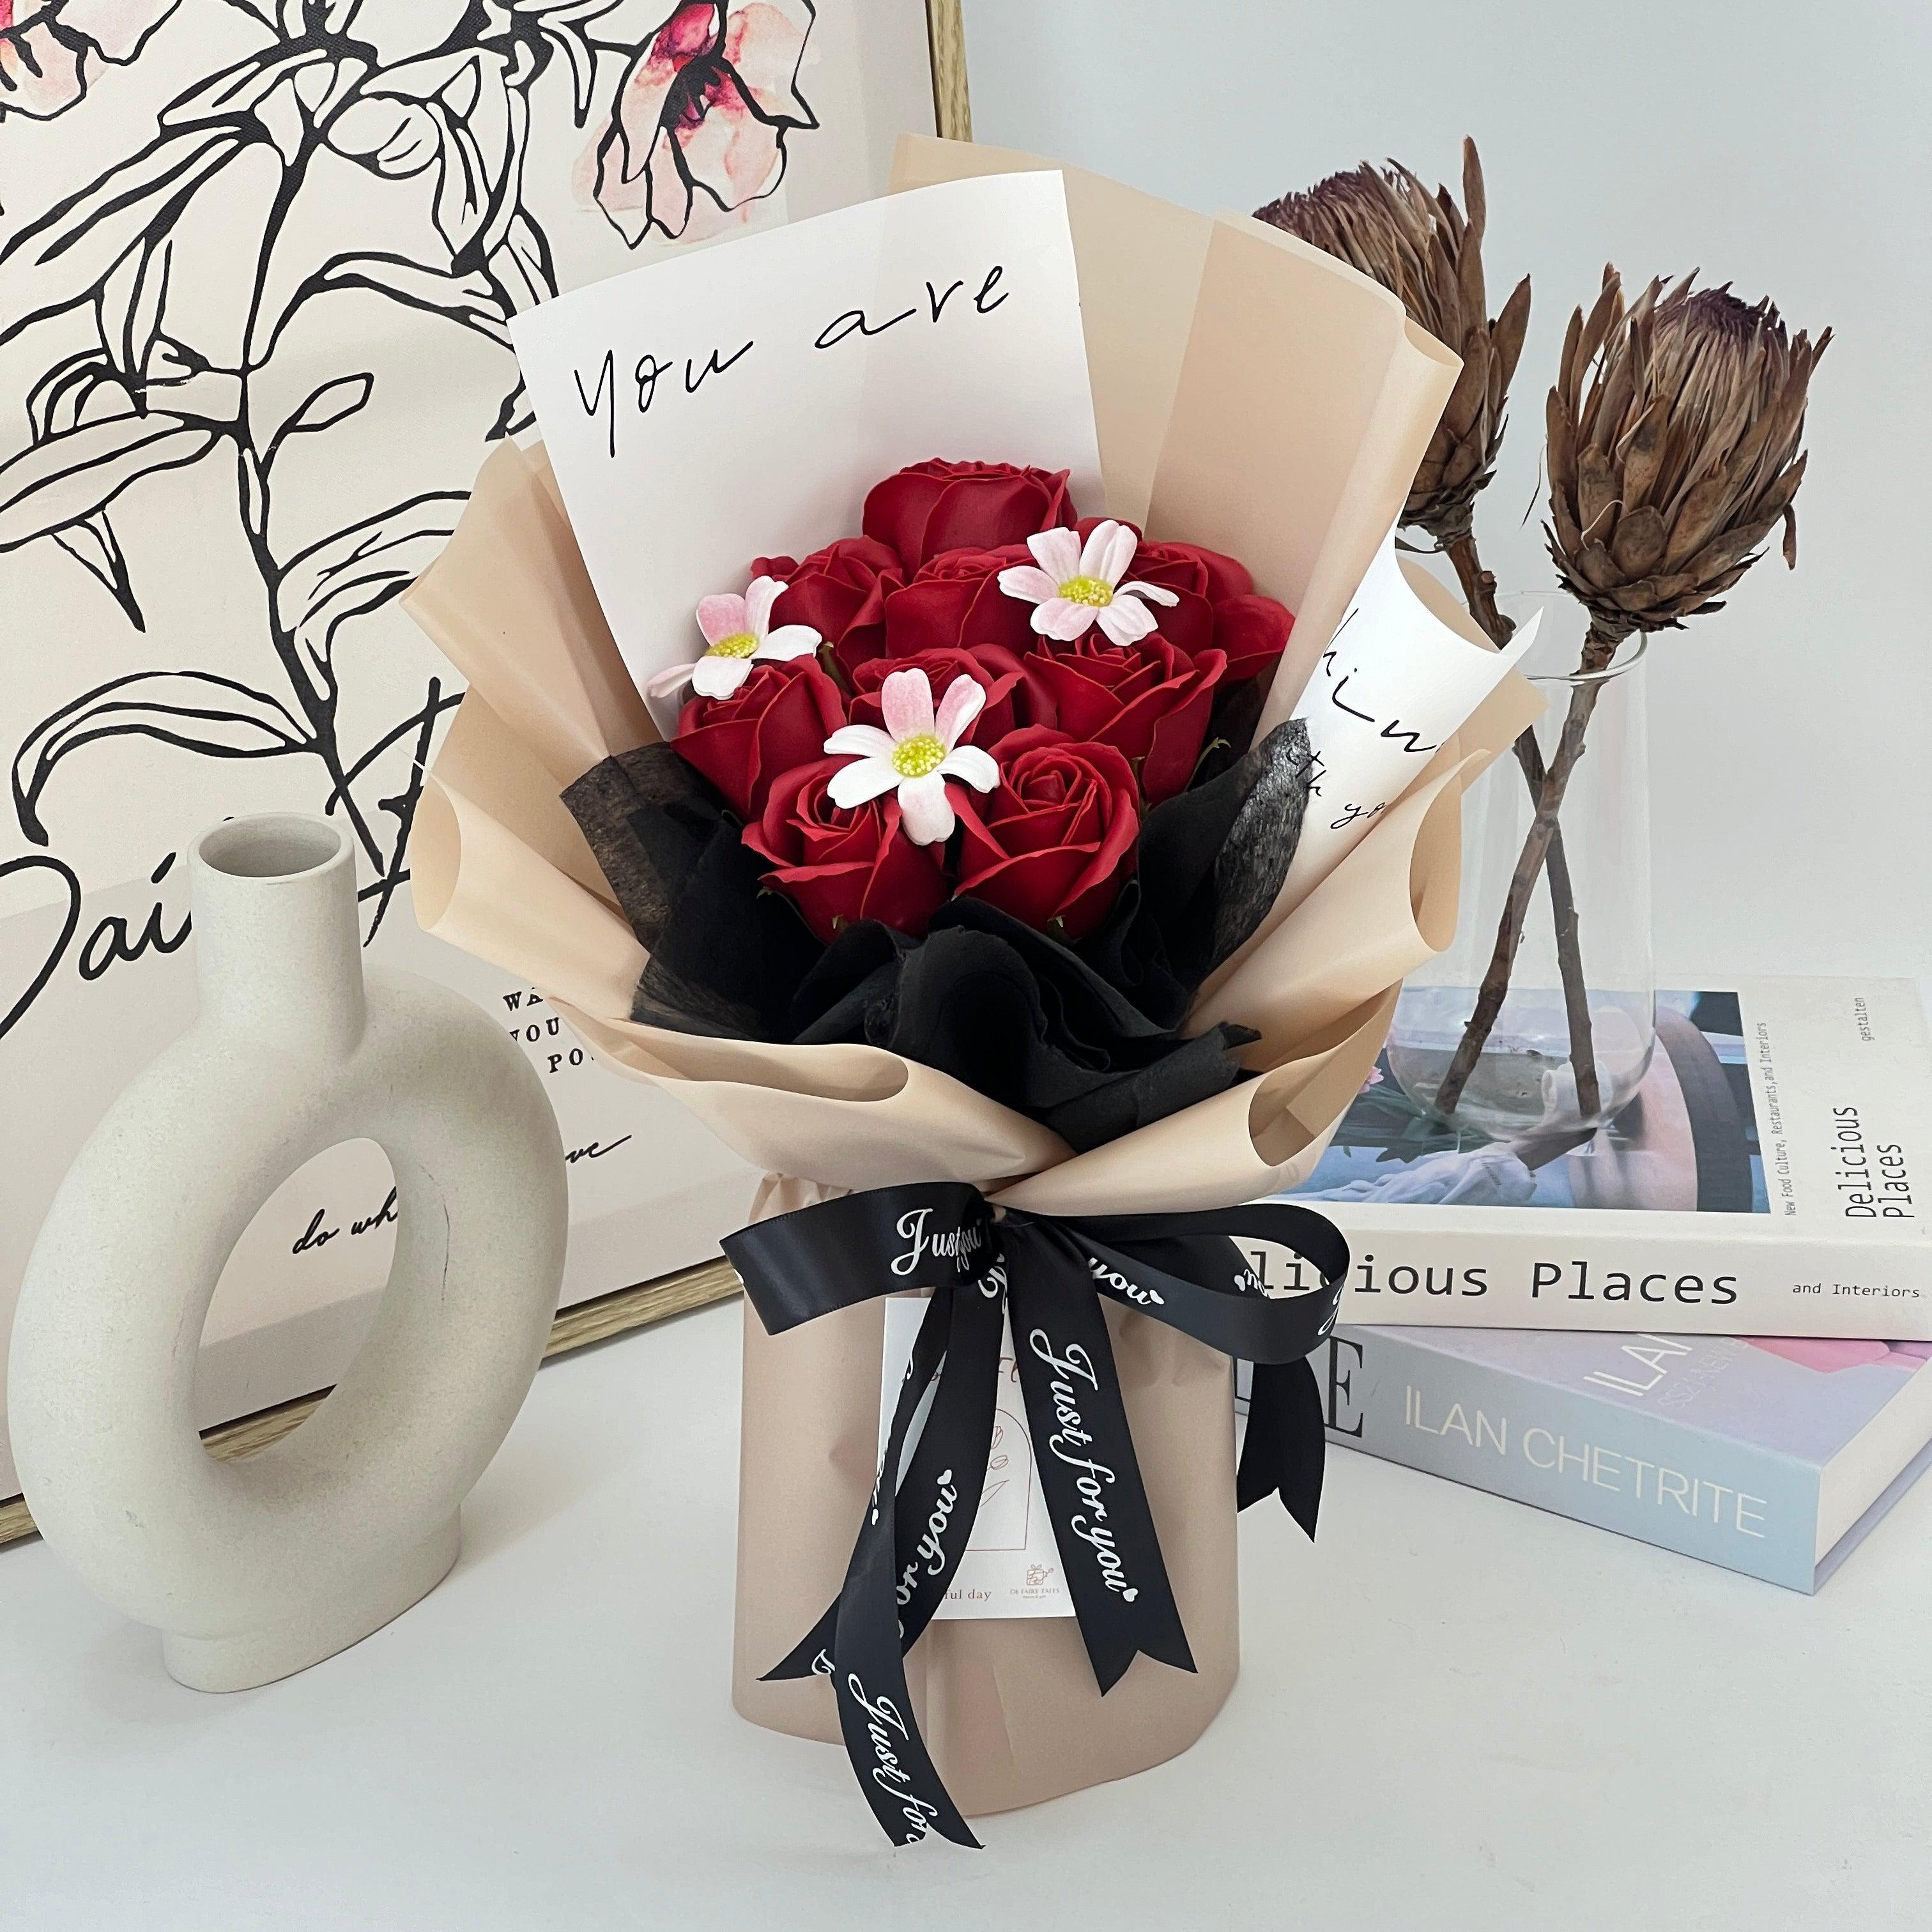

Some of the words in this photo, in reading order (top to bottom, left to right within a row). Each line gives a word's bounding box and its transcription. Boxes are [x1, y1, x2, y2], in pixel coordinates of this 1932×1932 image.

[814, 265, 1009, 349] are
[1756, 1022, 1772, 1062] Interiors
[1855, 997, 1875, 1041] gestalten
[547, 1048, 594, 1073] PO
[1775, 1140, 1790, 1175] Culture,
[1777, 1178, 1793, 1197] Food
[1830, 1107, 1877, 1218] Delicious
[1876, 1144, 1915, 1218] Places
[292, 1208, 341, 1254] do
[1784, 1201, 1797, 1216] New
[1531, 1261, 1738, 1305] Places
[1792, 1283, 1821, 1294] and
[1832, 1284, 1920, 1298] Interiors
[1029, 1328, 1099, 1446] Just
[1049, 1434, 1116, 1522] for
[1406, 1384, 1507, 1455] ILAN
[1522, 1427, 1767, 1539] CHETRITE
[896, 1561, 919, 1606] or
[916, 1484, 958, 1575] you
[1071, 1515, 1128, 1592] you
[967, 1588, 992, 1602] day
[848, 1673, 911, 1783] Just
